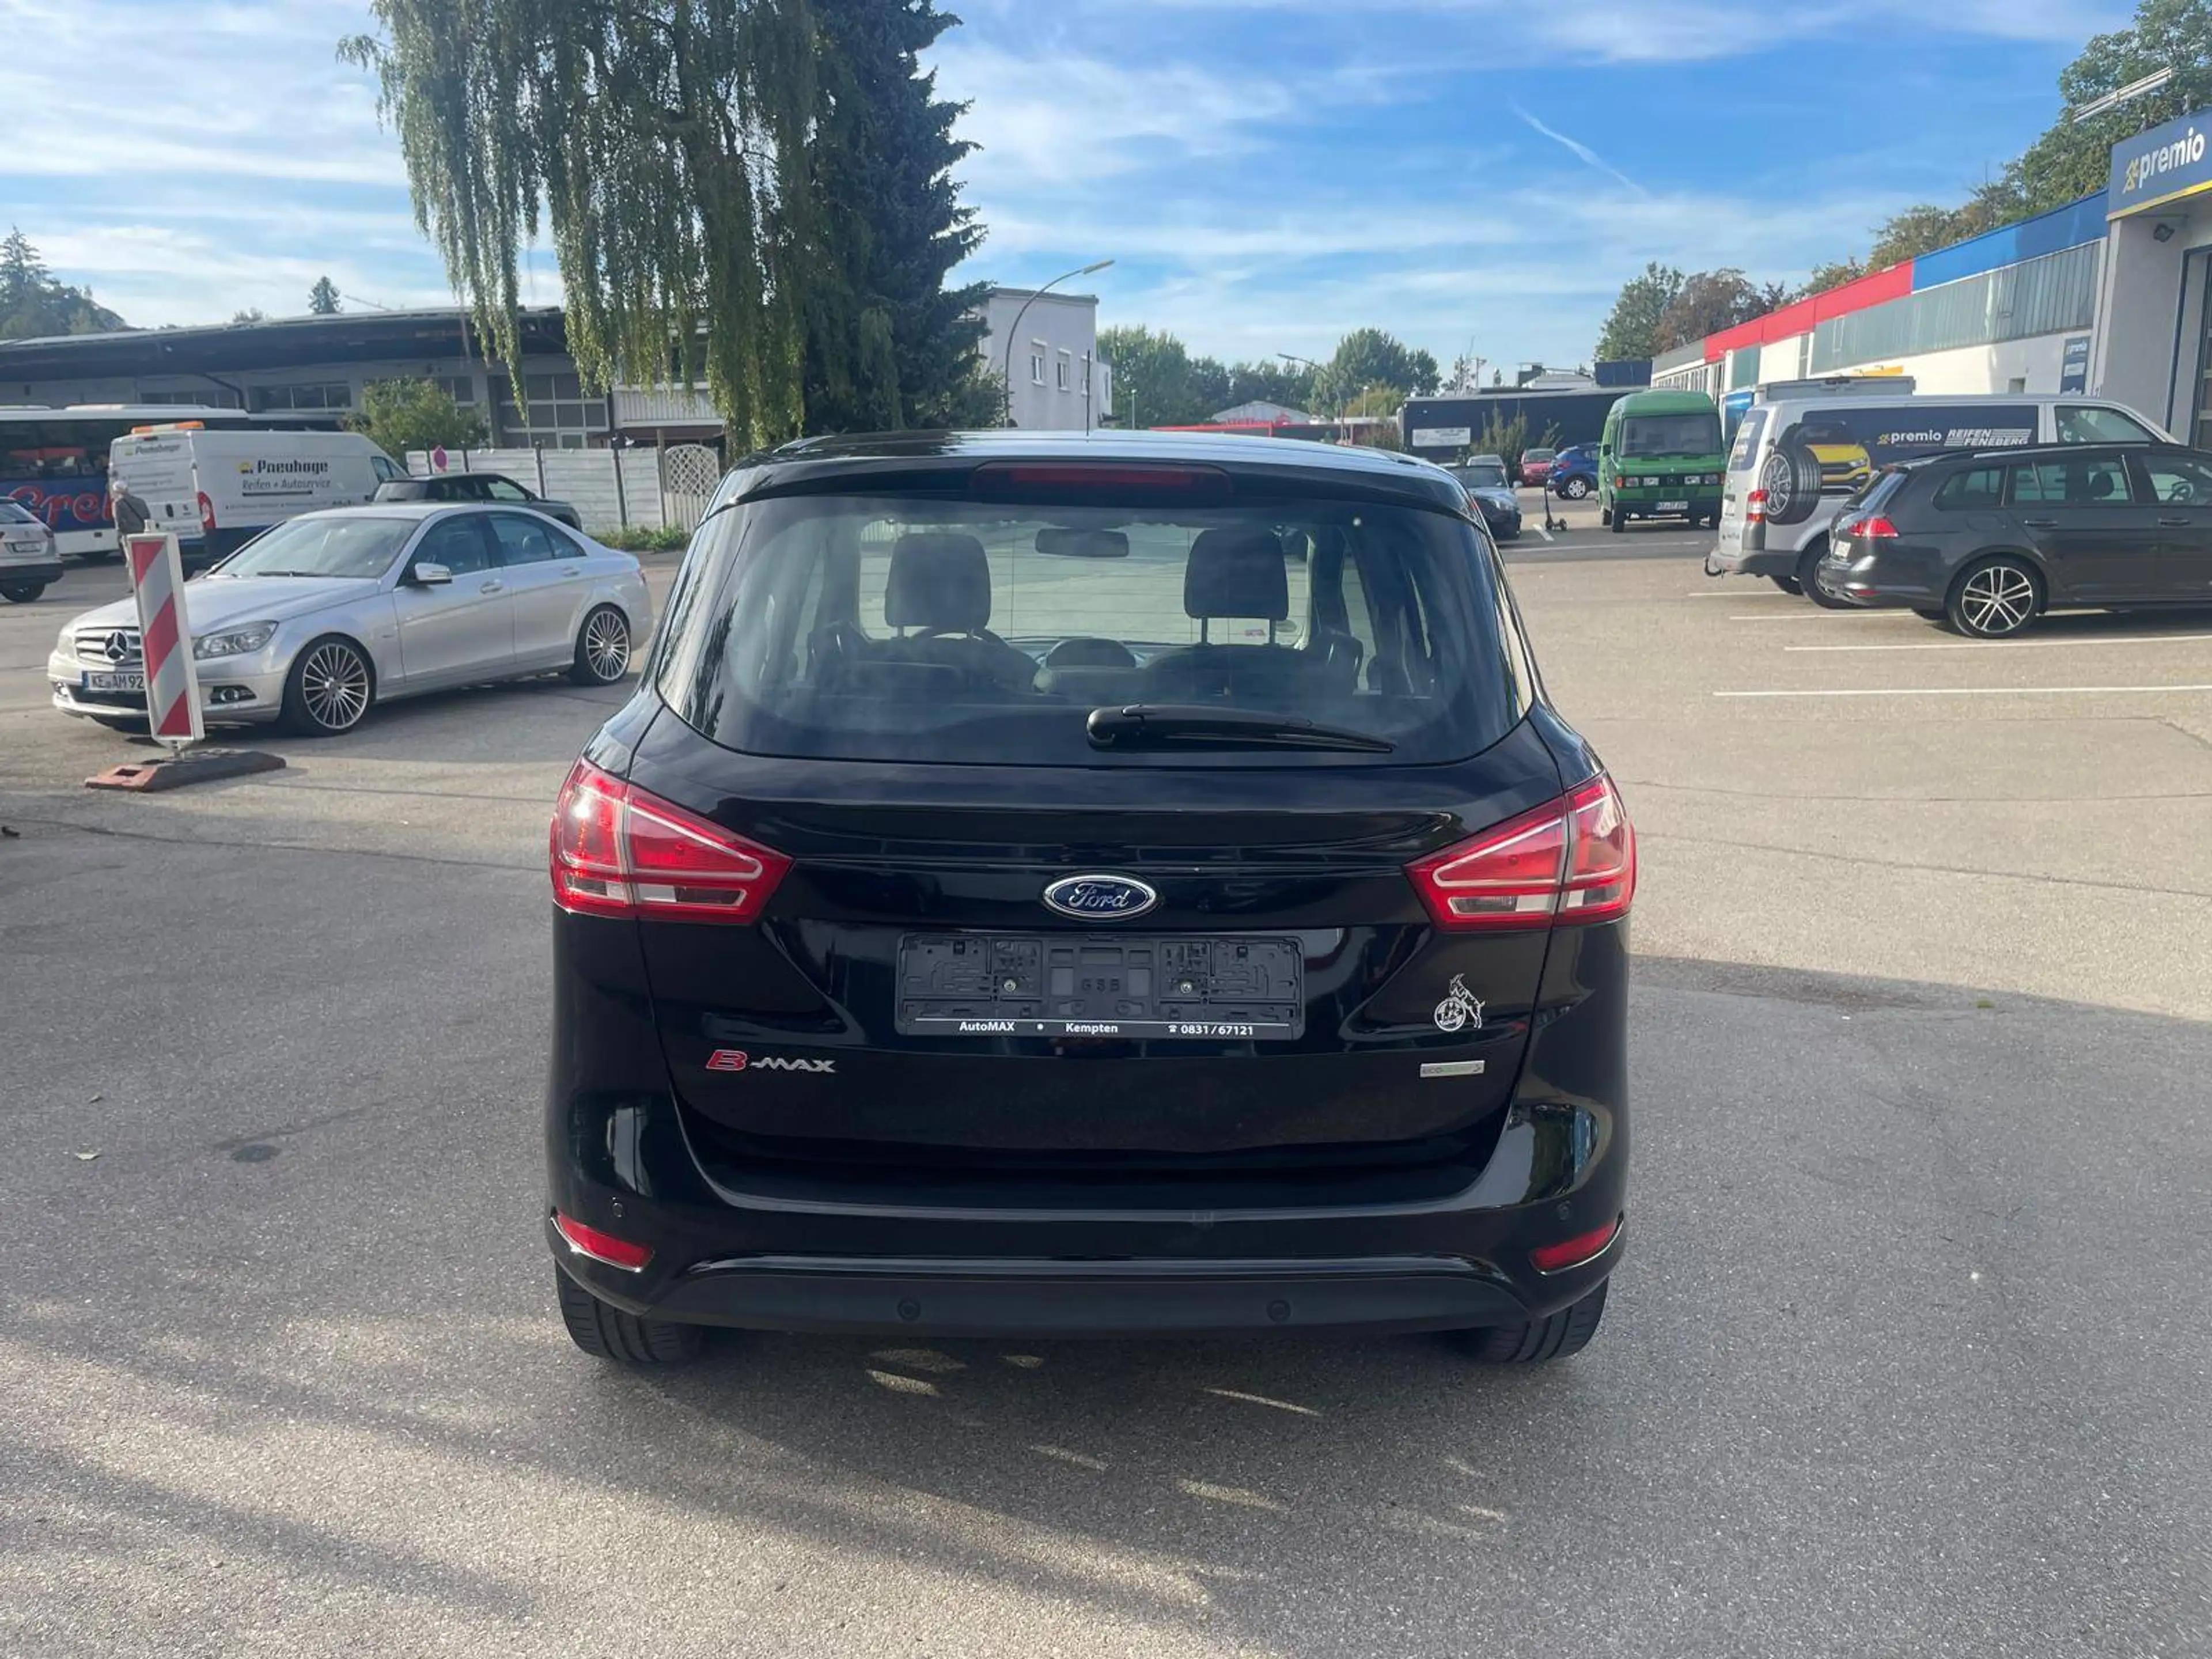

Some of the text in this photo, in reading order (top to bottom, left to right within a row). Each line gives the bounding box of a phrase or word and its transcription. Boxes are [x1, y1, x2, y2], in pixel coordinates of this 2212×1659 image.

[2139, 127, 2205, 189] premio
[1891, 430, 1942, 444] premio
[1948, 429, 1992, 438] REIFEN
[257, 460, 328, 474] Pneuhage
[1069, 882, 1130, 908] Ford
[959, 1021, 1253, 1035] AutoMAX Kempten 0831/67121
[706, 1049, 836, 1073] B-MAX
